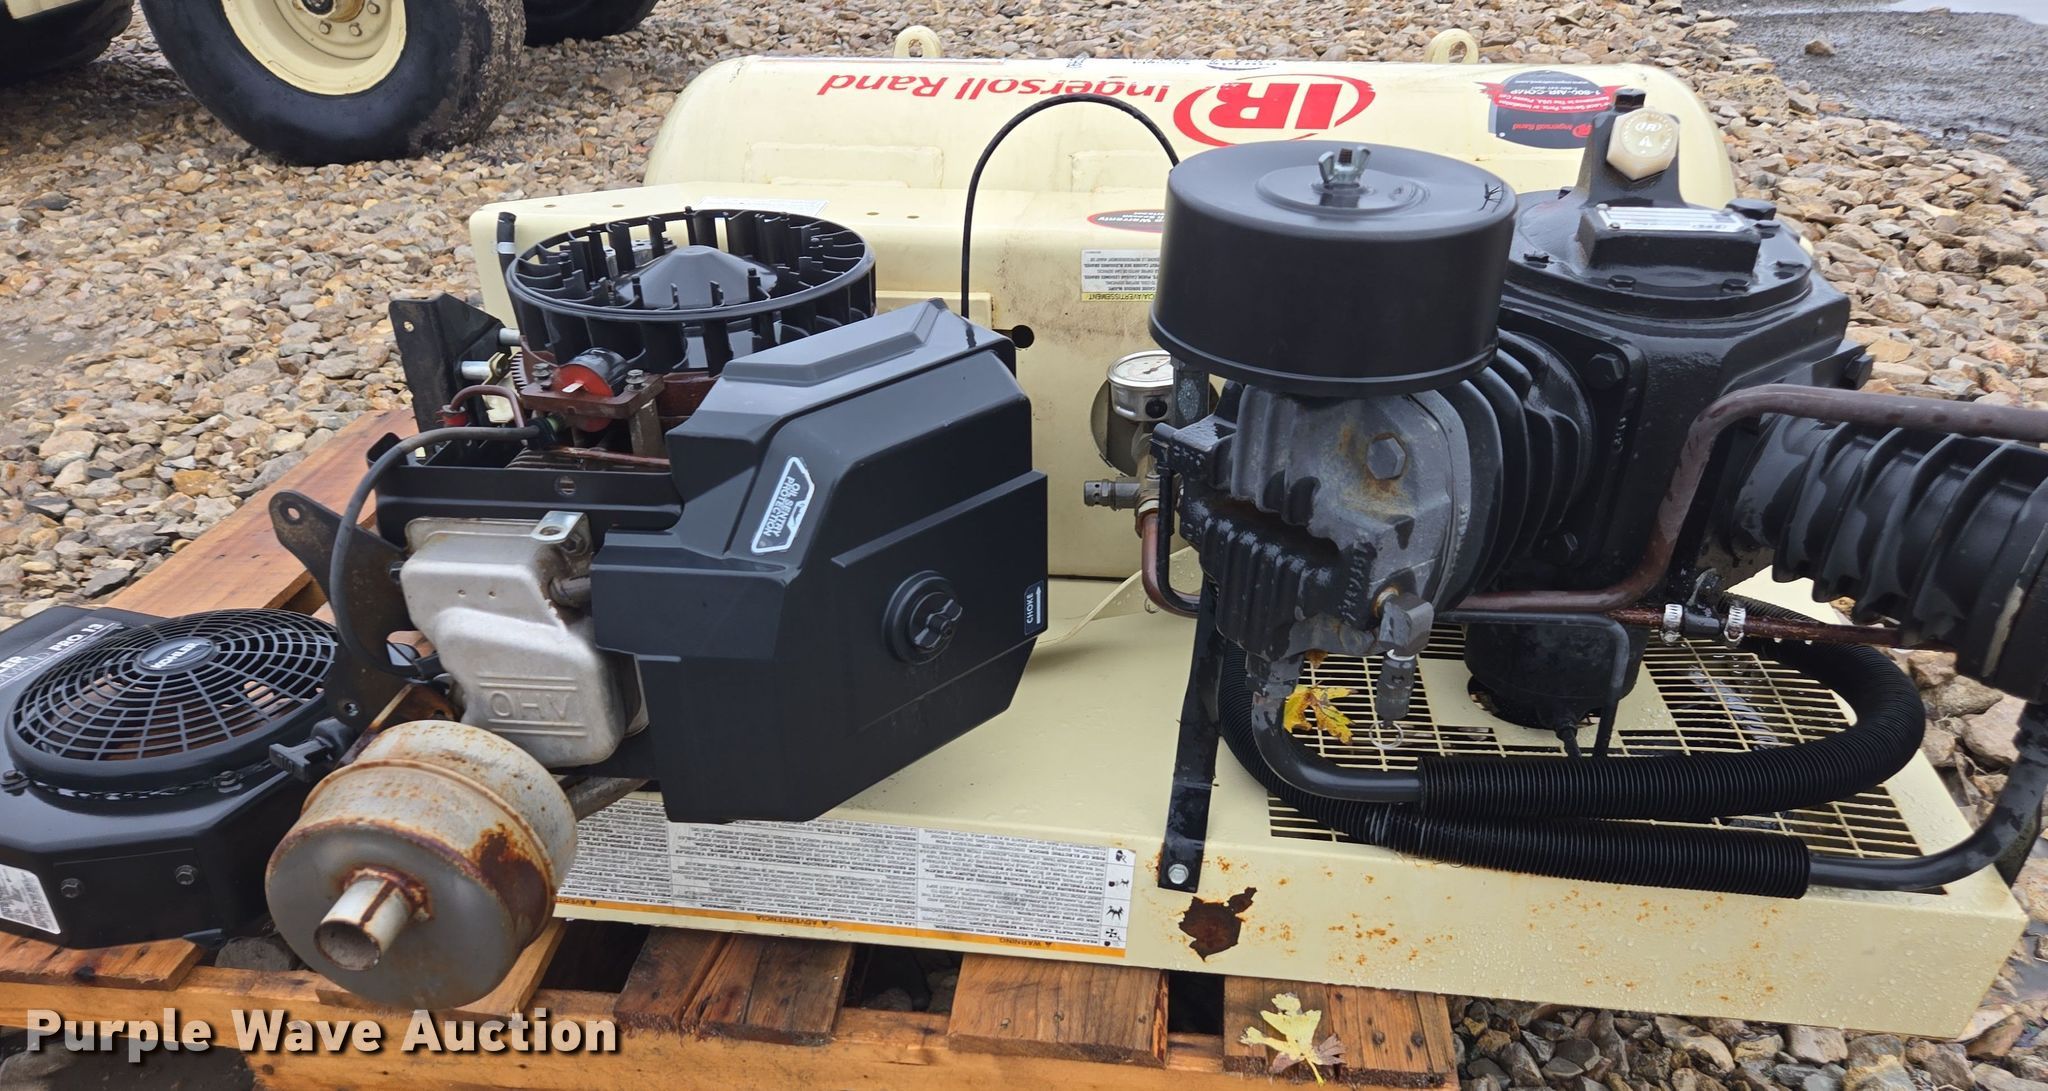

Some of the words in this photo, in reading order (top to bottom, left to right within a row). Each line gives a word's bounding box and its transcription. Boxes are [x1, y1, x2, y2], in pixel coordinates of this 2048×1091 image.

[817, 74, 948, 97] Rand
[954, 76, 1170, 103] Ingersoll
[788, 483, 801, 498] OIL
[763, 476, 796, 537] PROTECTION
[774, 499, 794, 538] SENTRY
[1026, 592, 1034, 624] CHOKE
[47, 634, 86, 652] PRO
[149, 642, 201, 669] KOHLER
[489, 690, 570, 720] OHV
